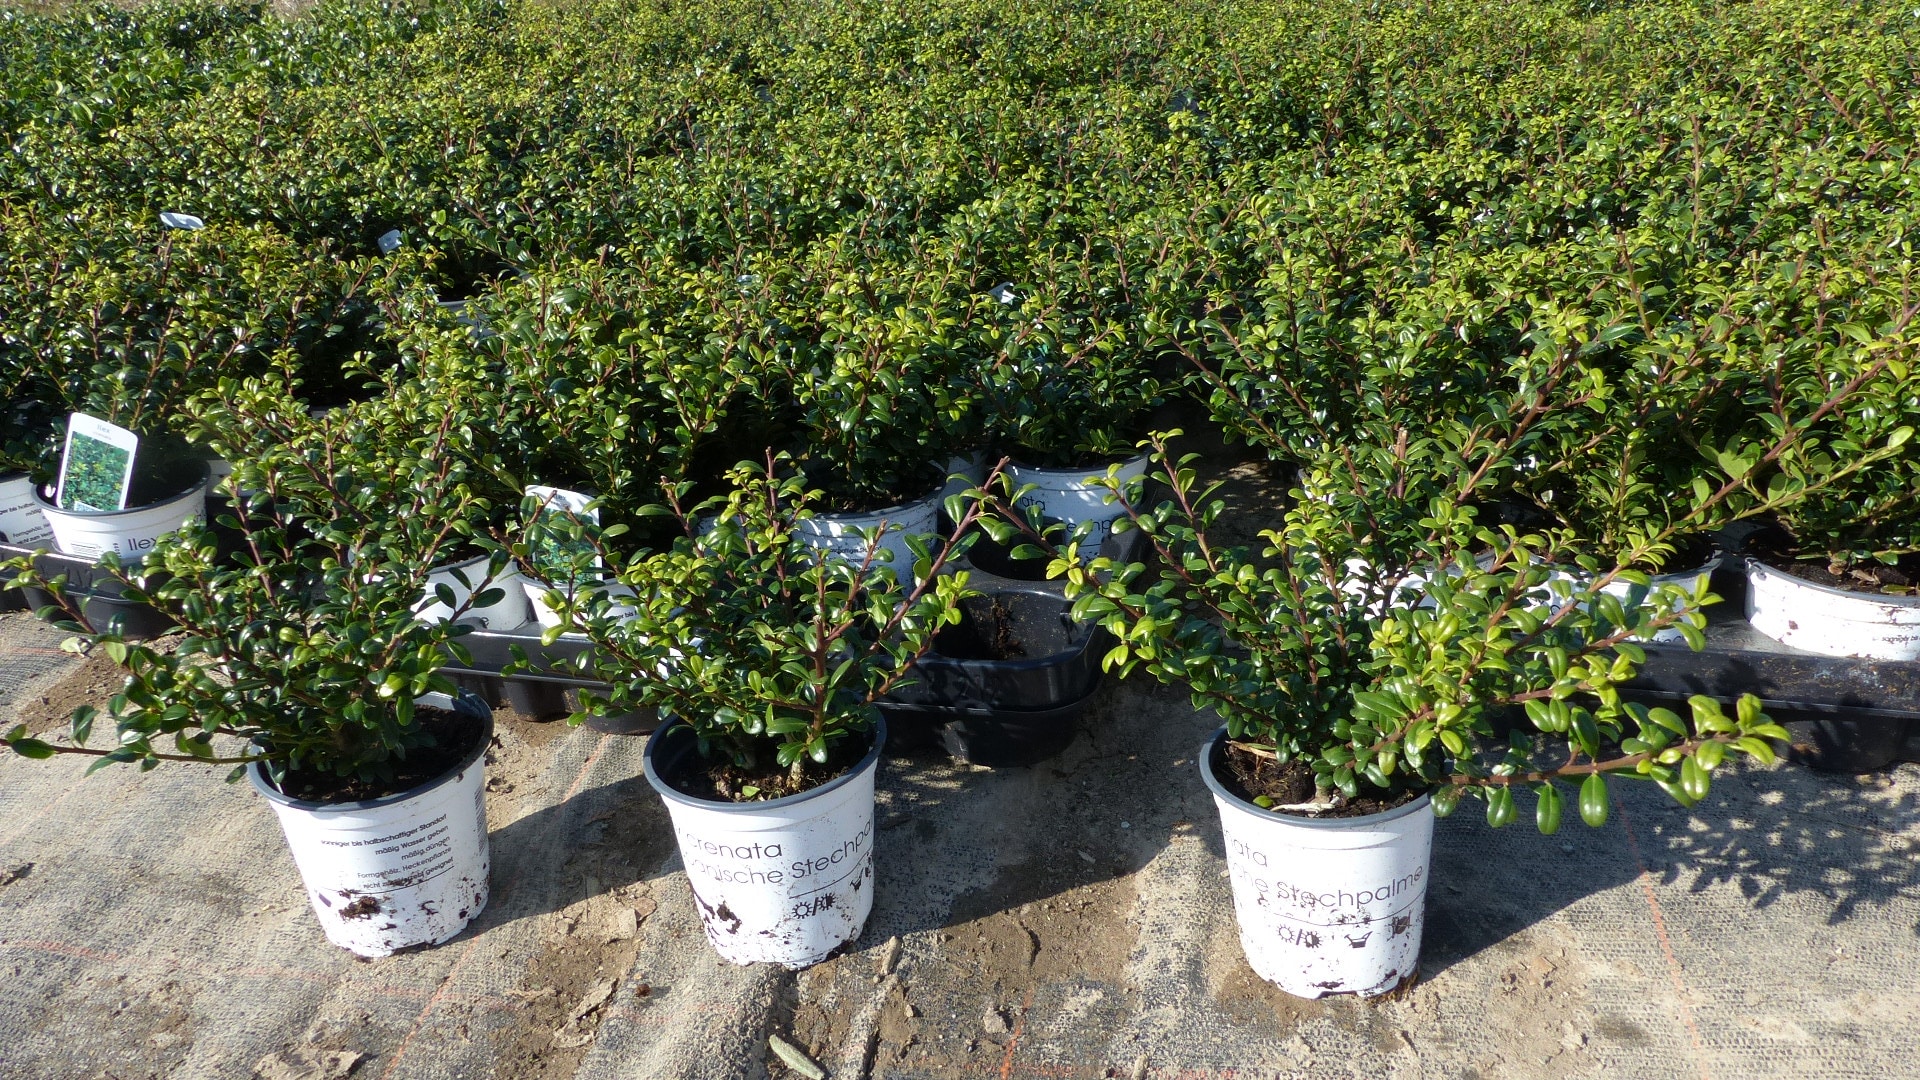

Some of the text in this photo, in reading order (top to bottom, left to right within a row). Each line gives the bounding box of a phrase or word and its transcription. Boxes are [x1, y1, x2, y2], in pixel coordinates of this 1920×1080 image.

[364, 828, 418, 846] halbschattiger
[419, 814, 447, 832] Standort
[400, 836, 426, 849] Wasser
[427, 825, 449, 841] geben
[425, 856, 454, 875] geeignet
[1276, 865, 1423, 909] Stechpalme
